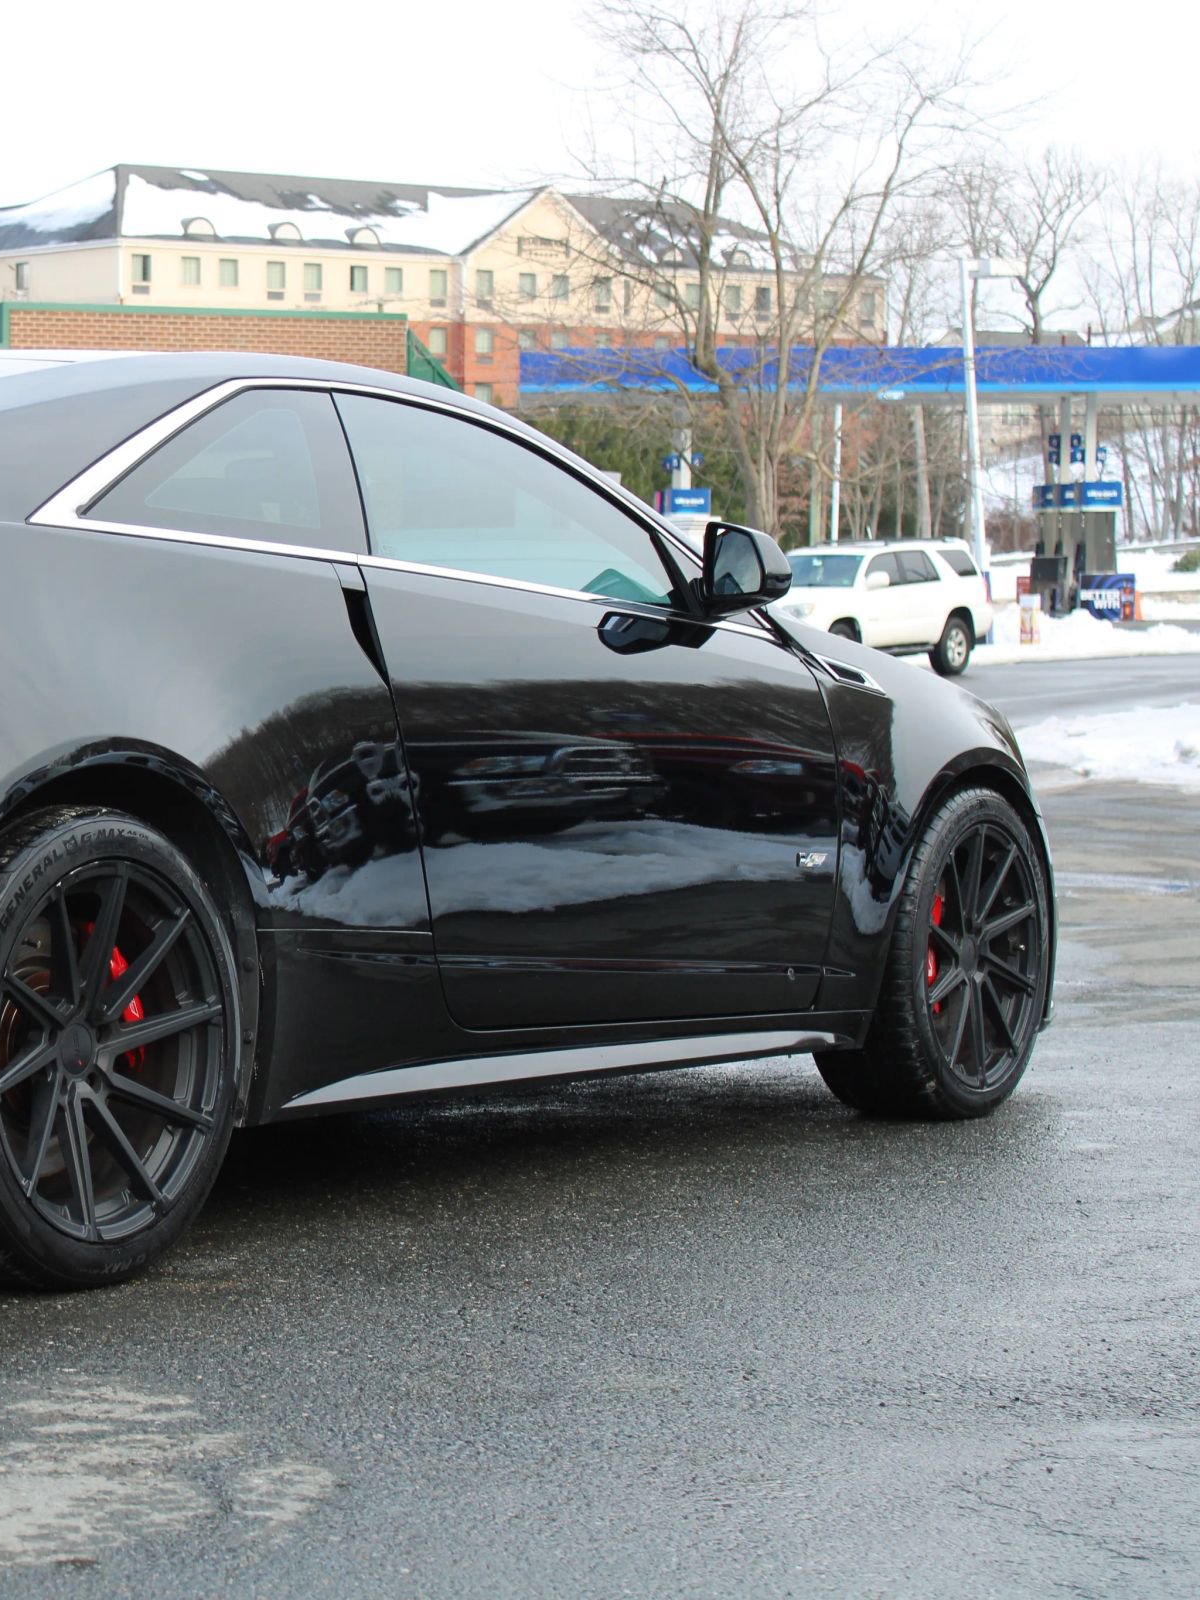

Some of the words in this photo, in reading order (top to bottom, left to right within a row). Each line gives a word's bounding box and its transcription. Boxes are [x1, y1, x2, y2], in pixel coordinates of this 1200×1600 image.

[1080, 589, 1120, 600] BETTER
[1095, 600, 1120, 609] WITH
[0, 848, 63, 933] GENERAL
